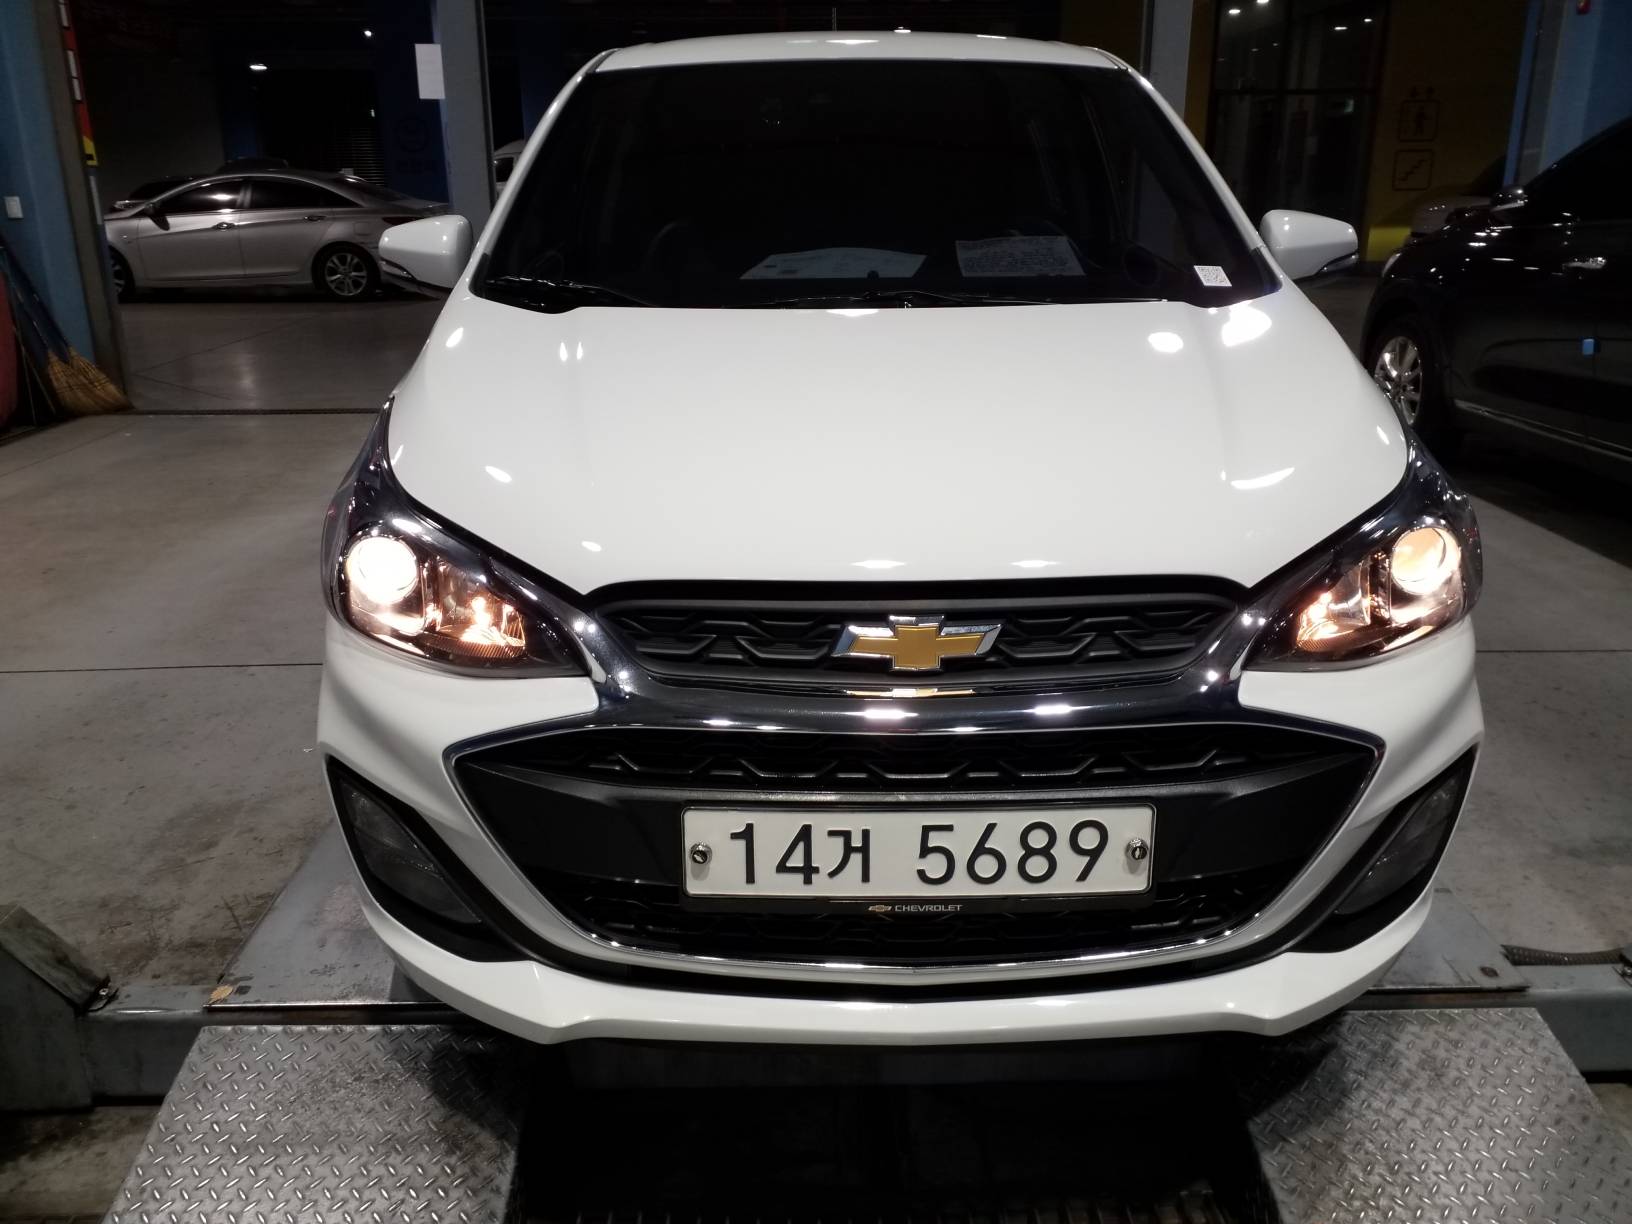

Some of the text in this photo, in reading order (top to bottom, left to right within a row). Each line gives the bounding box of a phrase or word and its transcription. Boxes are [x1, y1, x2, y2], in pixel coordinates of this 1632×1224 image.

[730, 819, 1109, 885] 14거 5689
[894, 904, 963, 912] CHEVROLET
